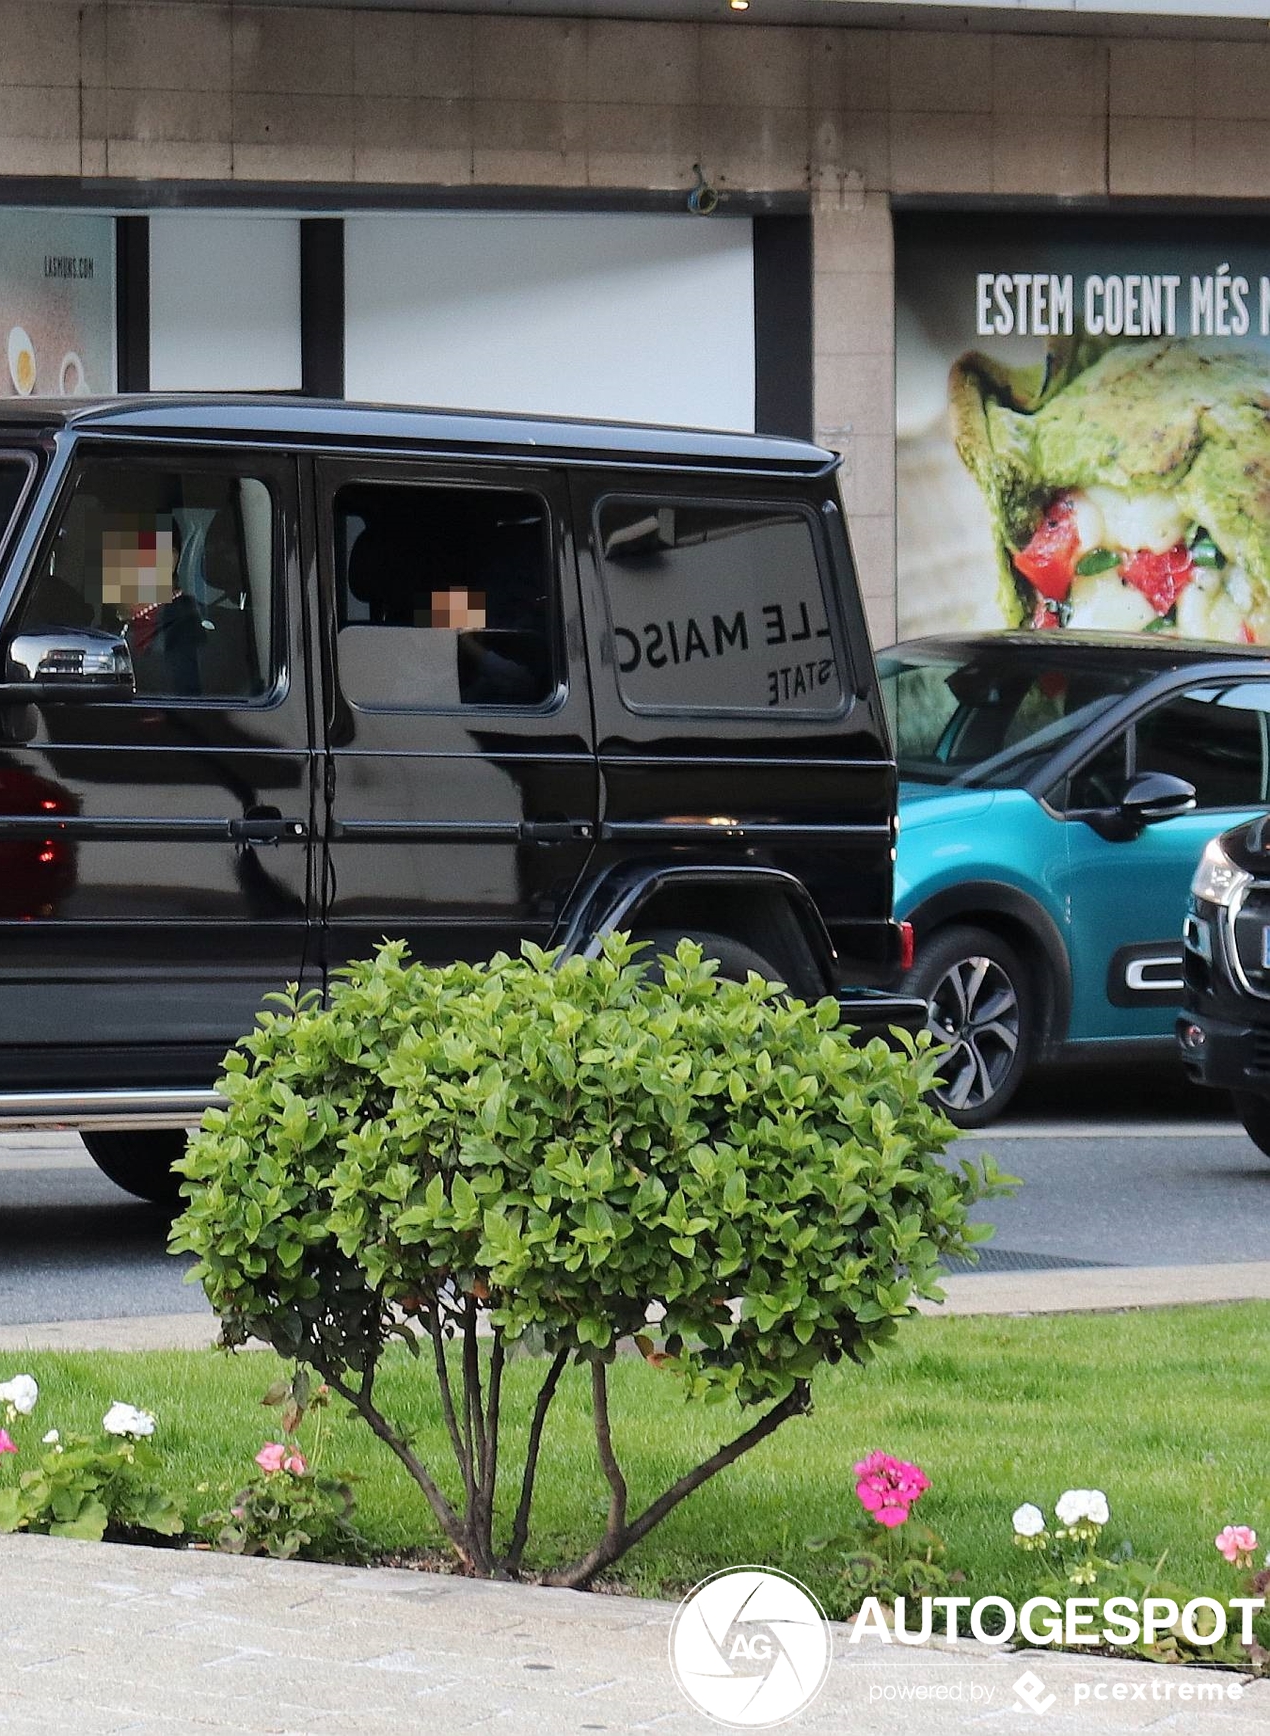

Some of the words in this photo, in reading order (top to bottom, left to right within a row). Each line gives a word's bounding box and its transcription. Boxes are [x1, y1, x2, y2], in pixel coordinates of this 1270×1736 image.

[976, 273, 1074, 336] ESTEM
[1084, 275, 1181, 336] COENT
[1189, 262, 1250, 336] MÉS
